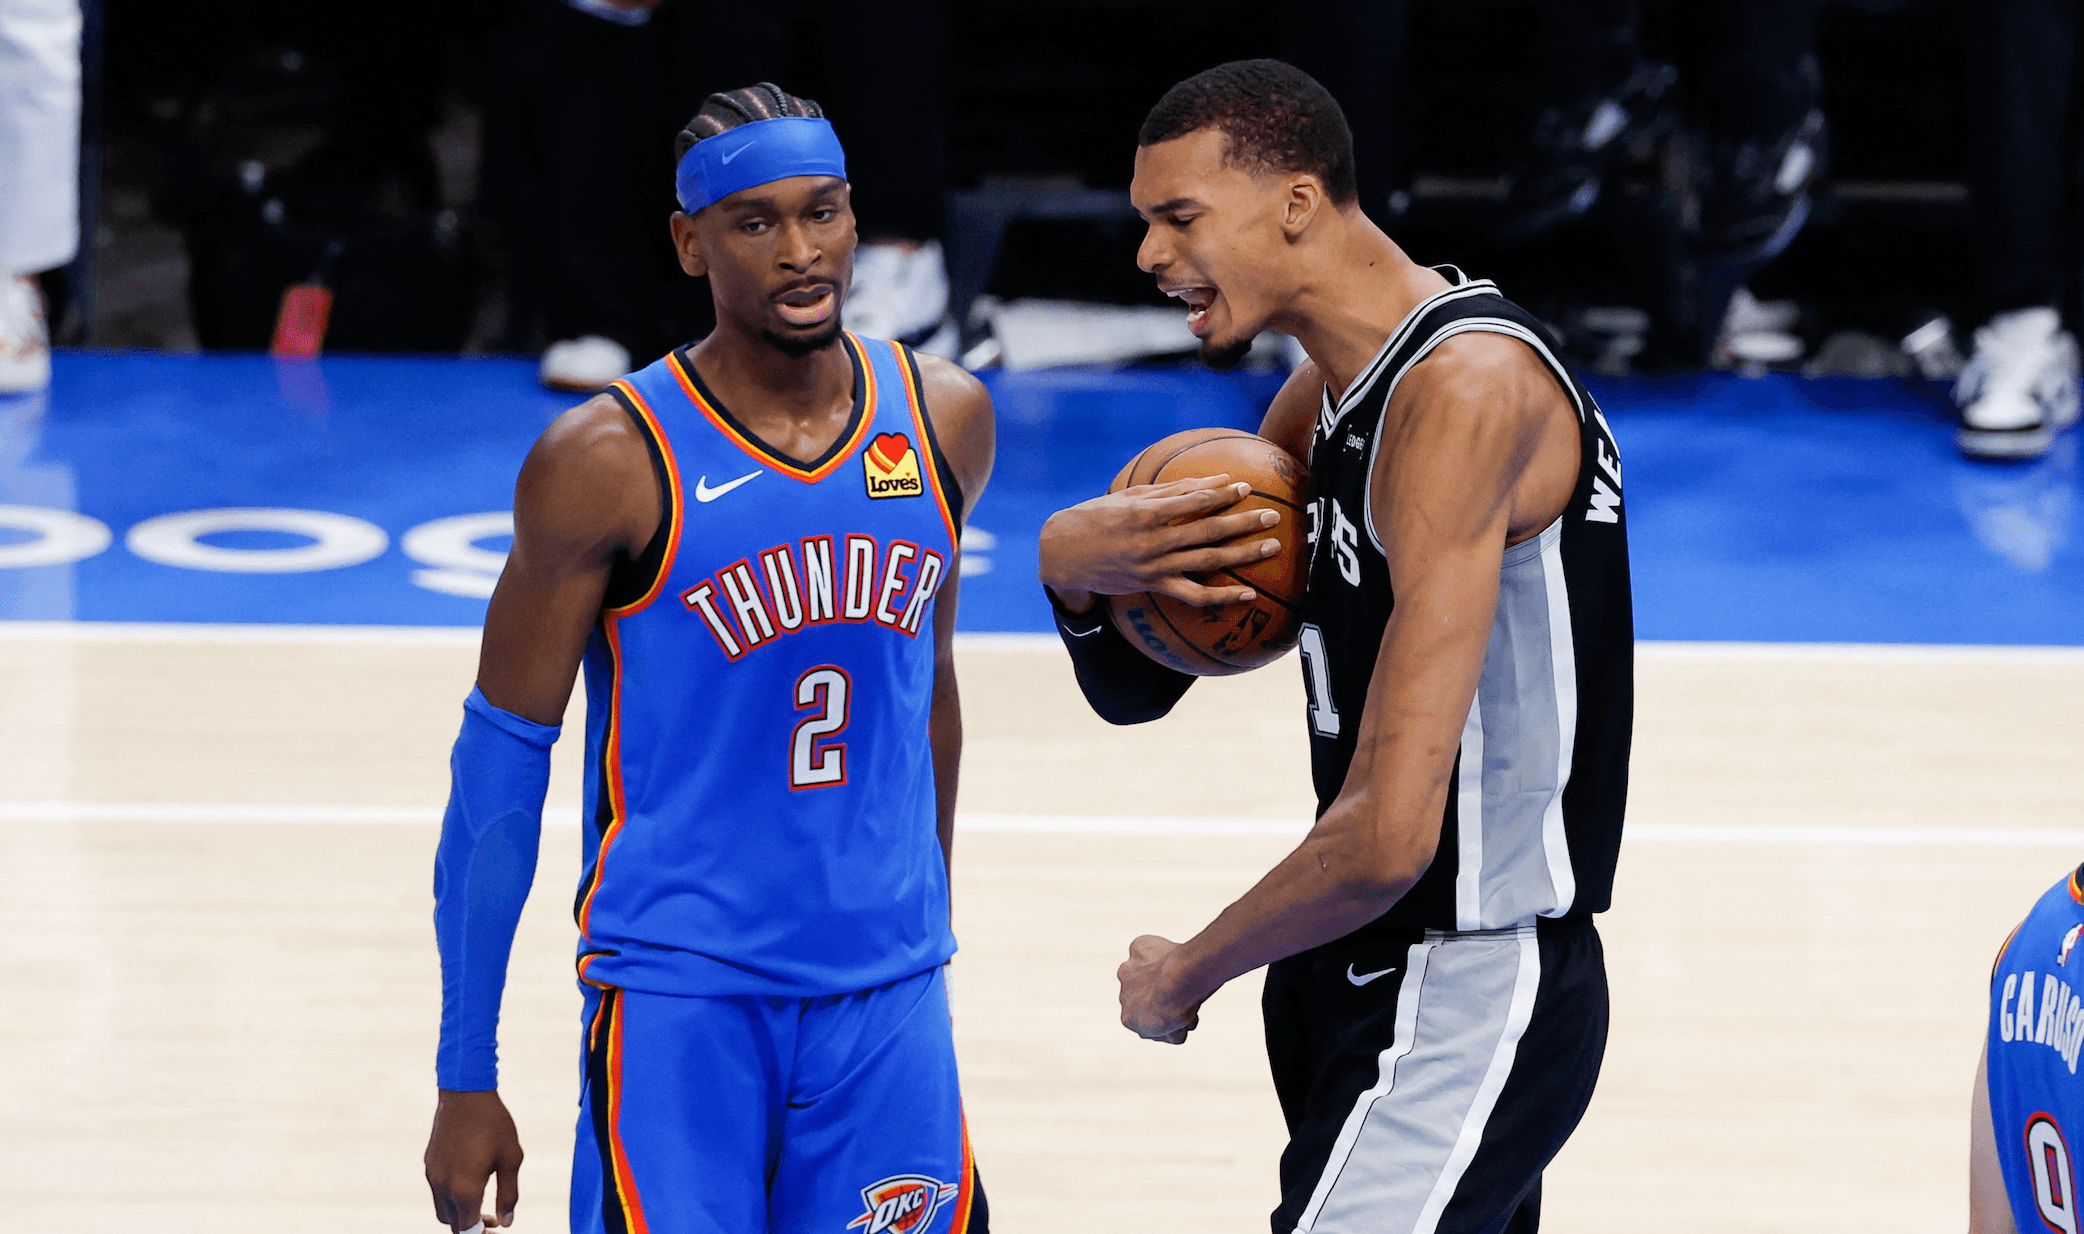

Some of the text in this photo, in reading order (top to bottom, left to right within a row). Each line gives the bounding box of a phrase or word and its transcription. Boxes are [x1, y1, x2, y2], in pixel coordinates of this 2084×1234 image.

[680, 533, 943, 662] THUNDER
[789, 664, 851, 791] 2
[1298, 621, 1340, 738] 1
[868, 1186, 926, 1234] OKC
